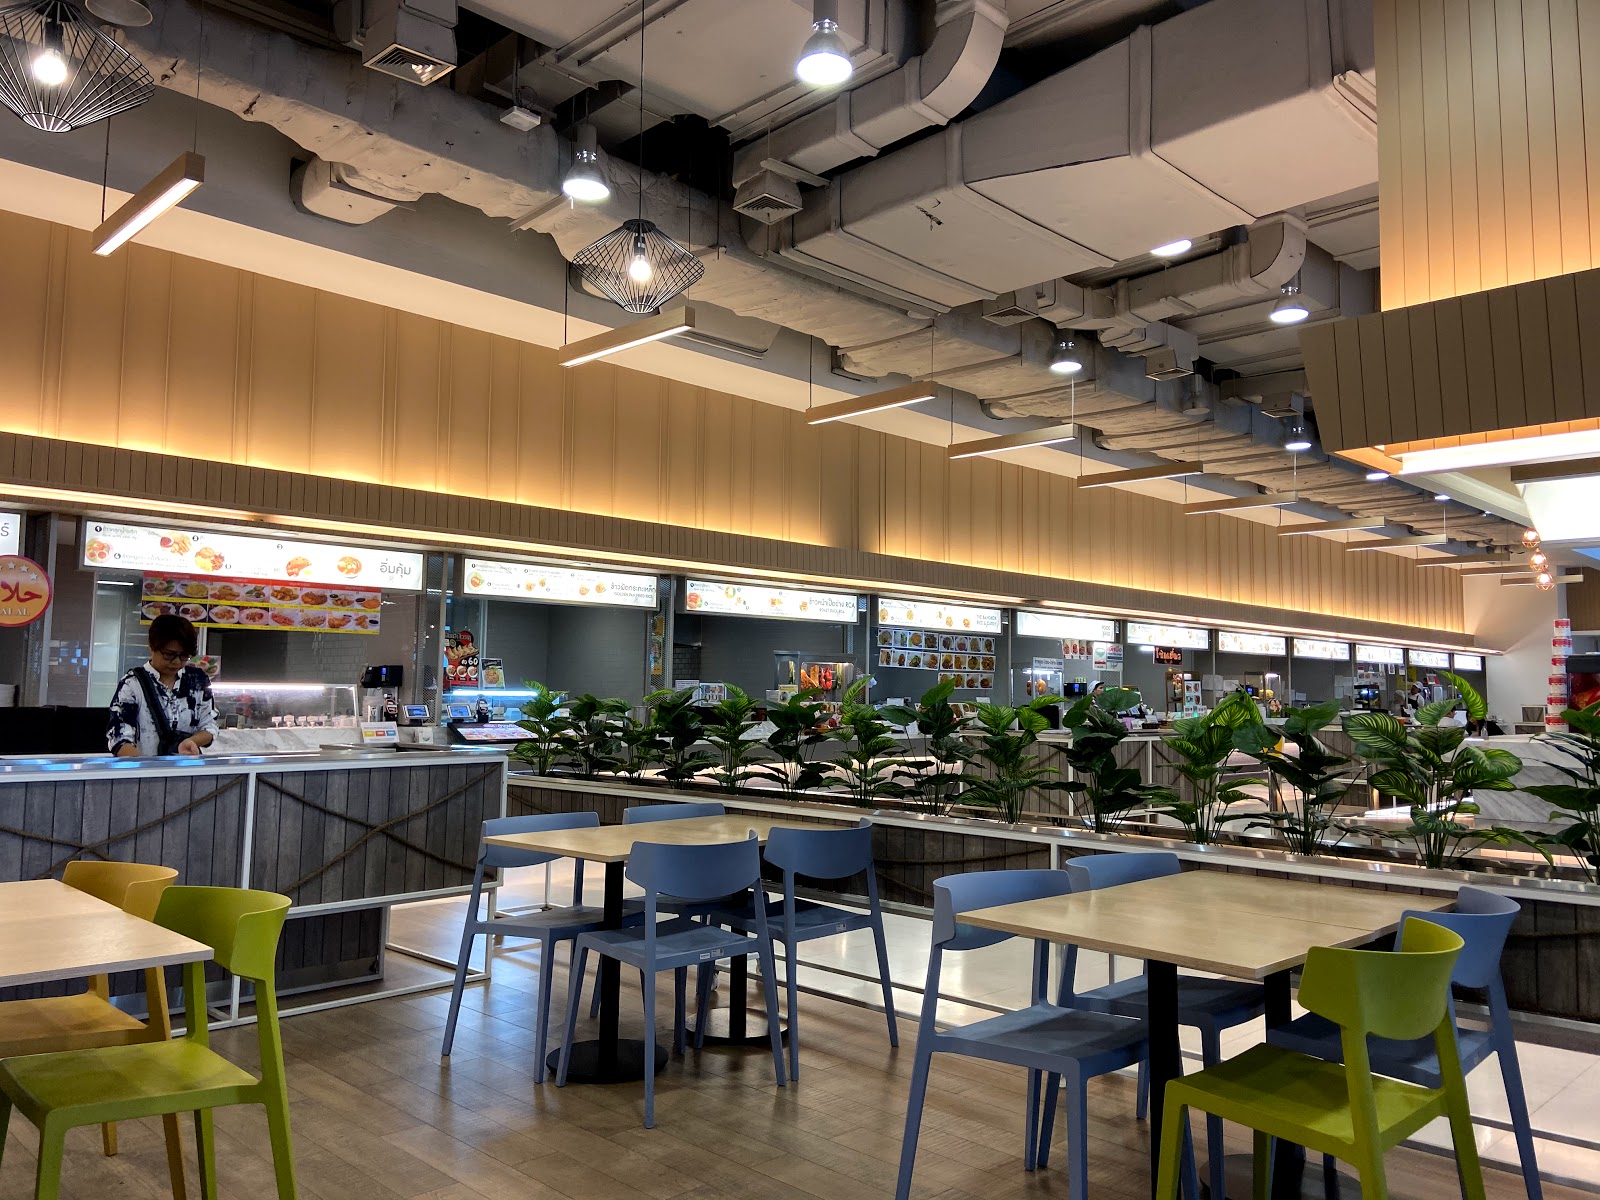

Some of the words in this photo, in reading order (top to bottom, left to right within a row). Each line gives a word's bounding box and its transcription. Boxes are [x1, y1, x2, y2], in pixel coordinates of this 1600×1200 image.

[379, 558, 411, 579] อิ่มคุ้ม
[468, 657, 478, 666] 60
